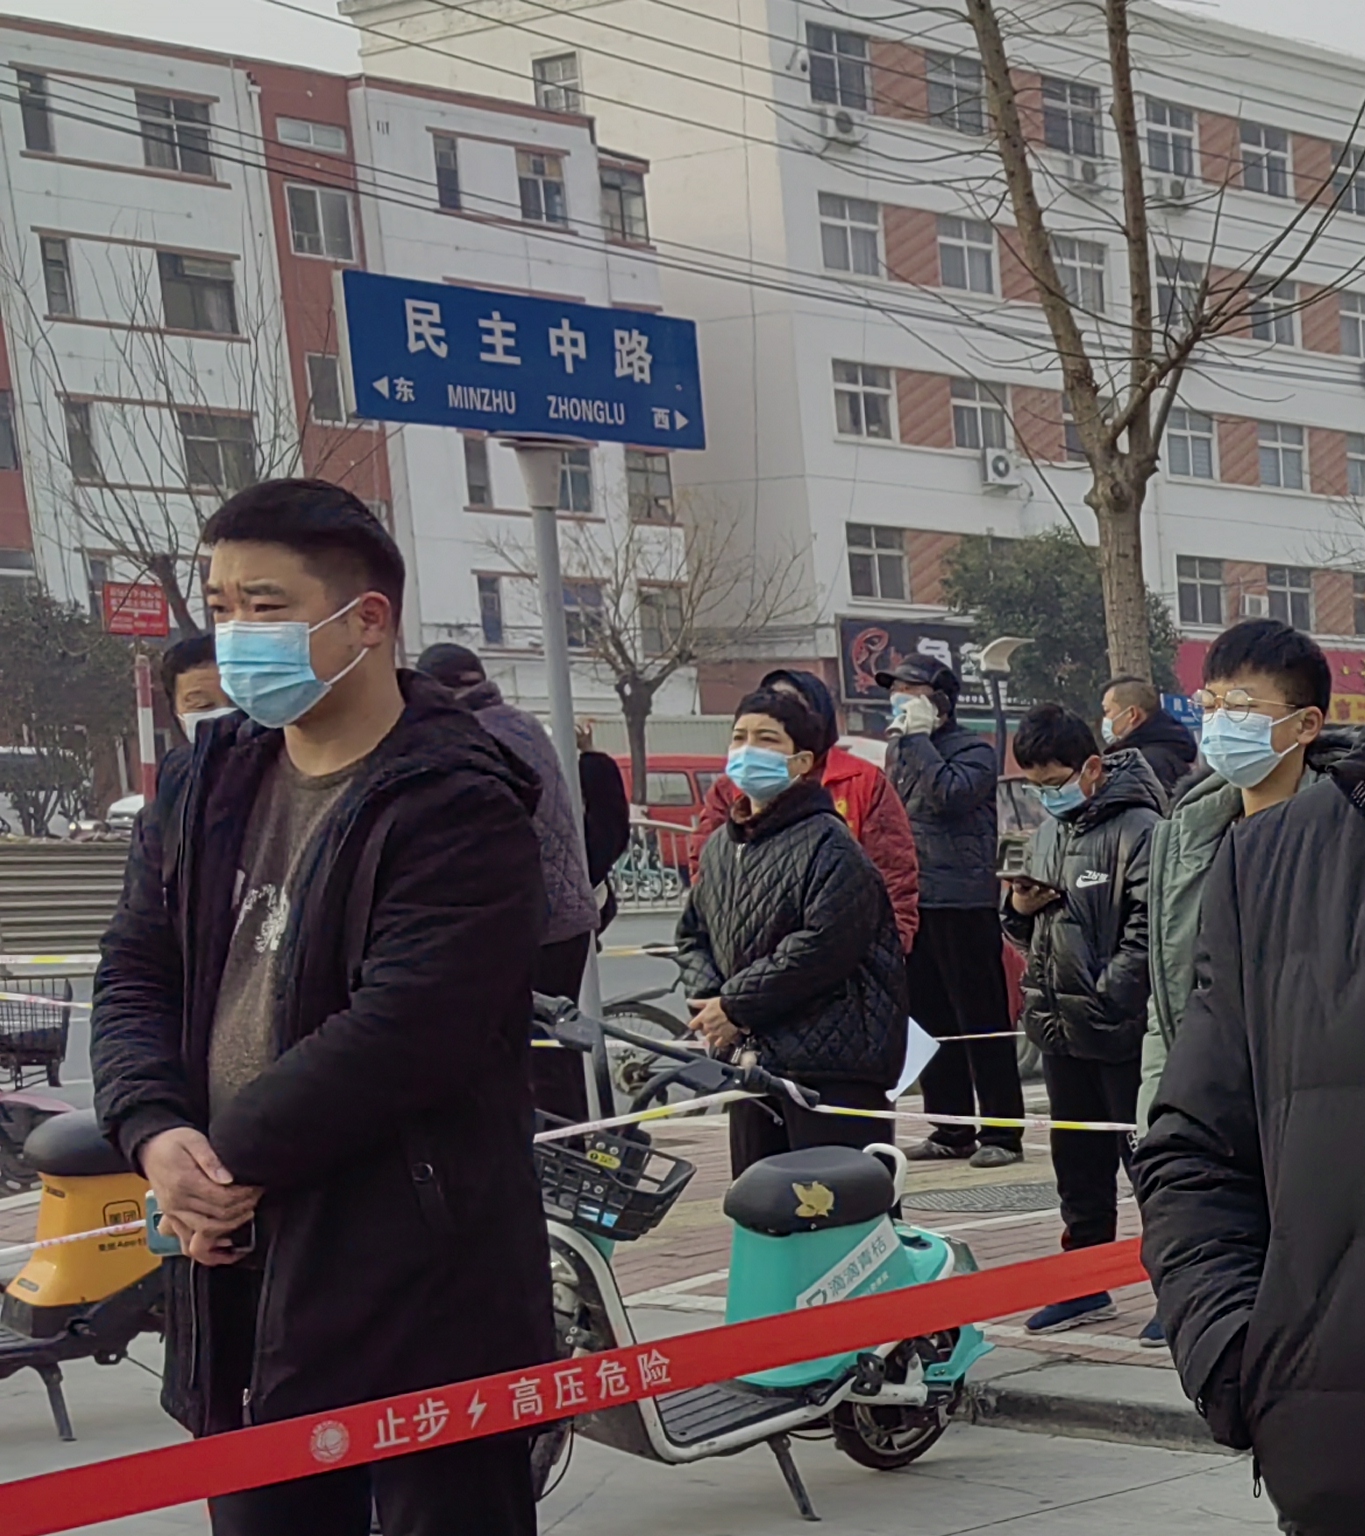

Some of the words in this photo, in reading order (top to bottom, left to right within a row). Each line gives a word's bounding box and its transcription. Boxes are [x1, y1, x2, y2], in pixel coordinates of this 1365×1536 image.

[404, 298, 653, 385] 民主中路
[393, 376, 416, 403] 东
[447, 383, 517, 415] MINZHU
[546, 394, 626, 426] ZHONGLU
[651, 407, 671, 431] 西
[373, 1398, 450, 1450] 止步
[508, 1349, 672, 1420] 高压危险
